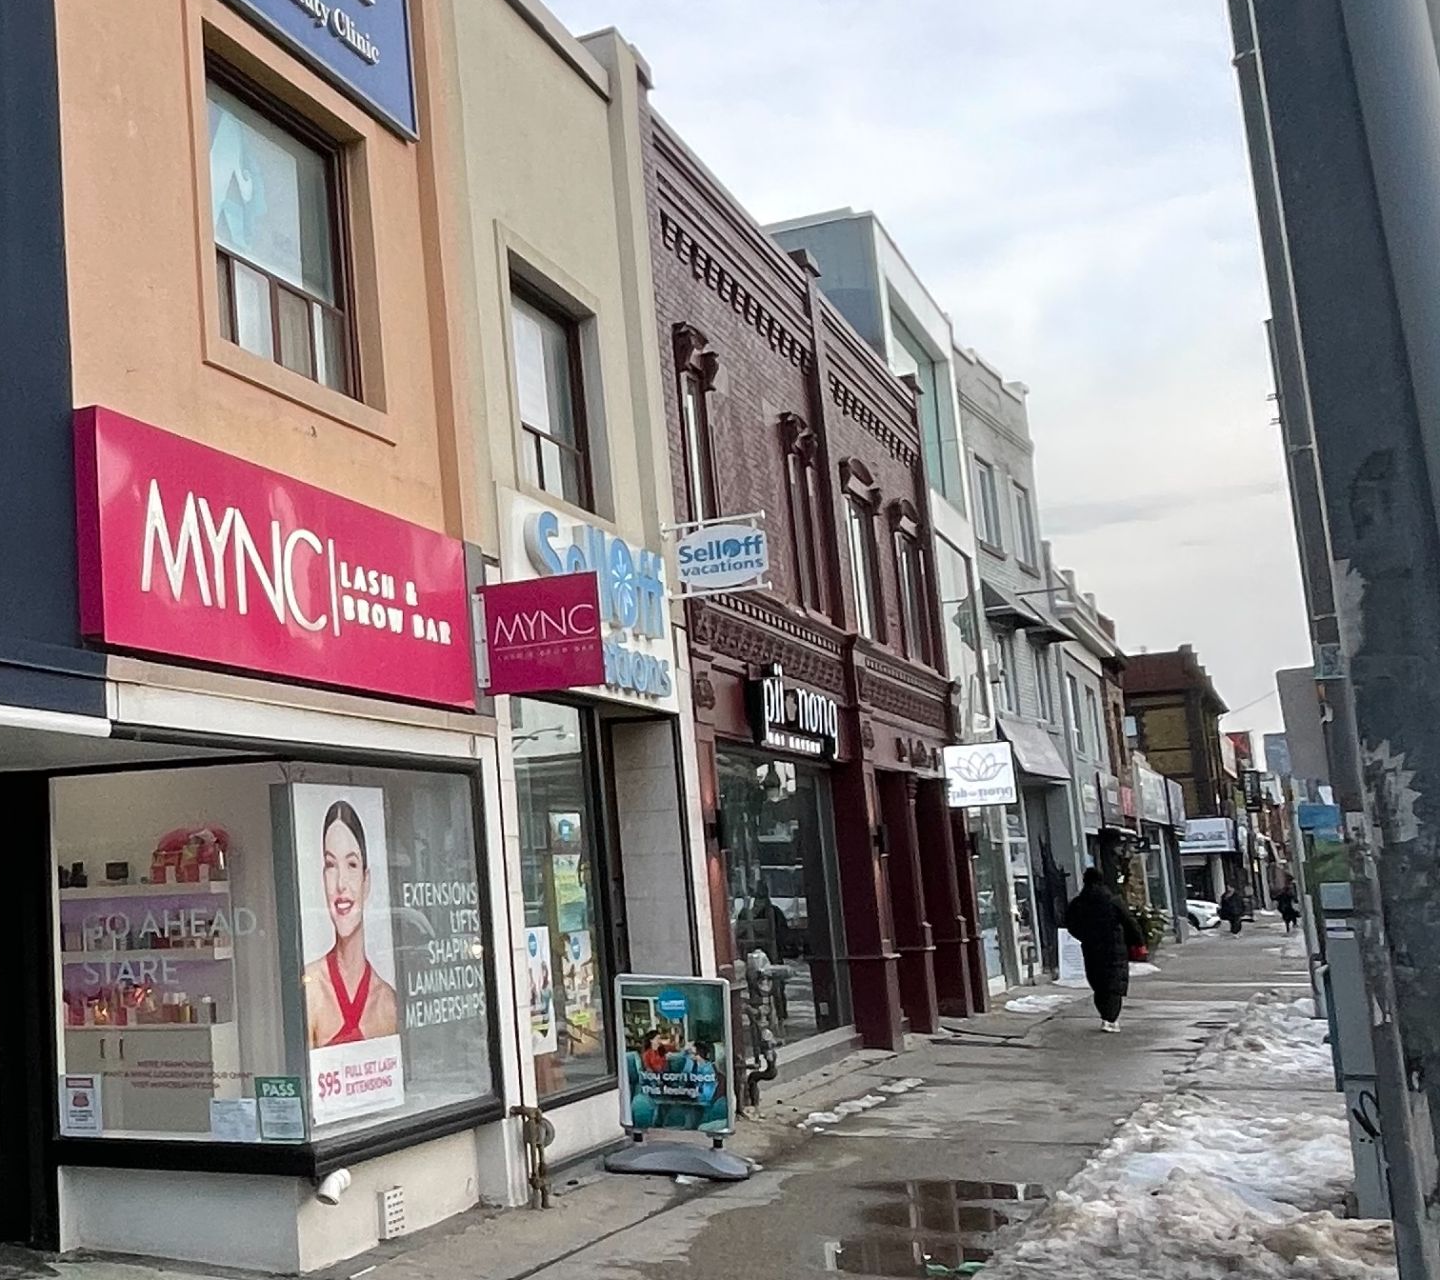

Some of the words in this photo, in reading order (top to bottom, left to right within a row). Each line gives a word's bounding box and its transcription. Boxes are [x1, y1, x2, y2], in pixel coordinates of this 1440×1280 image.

[329, 7, 380, 66] Clinic
[141, 478, 325, 633] MYNC
[679, 535, 763, 564] SellOff
[340, 561, 395, 600] LASH
[681, 558, 764, 577] vacations
[342, 595, 403, 634] BROW
[412, 614, 451, 645] BAR
[494, 604, 595, 646] MYNC
[403, 882, 478, 907] EXTENSIONS
[139, 907, 265, 940] AHEAD.
[450, 909, 480, 933] LIFTS
[82, 956, 179, 985] STARE
[408, 965, 484, 996] LAMINATION
[405, 992, 486, 1029] MEMBERSHIPS
[262, 1083, 295, 1096] PASS
[318, 1071, 341, 1098] $95
[345, 1075, 392, 1095] EXTENSIONS
